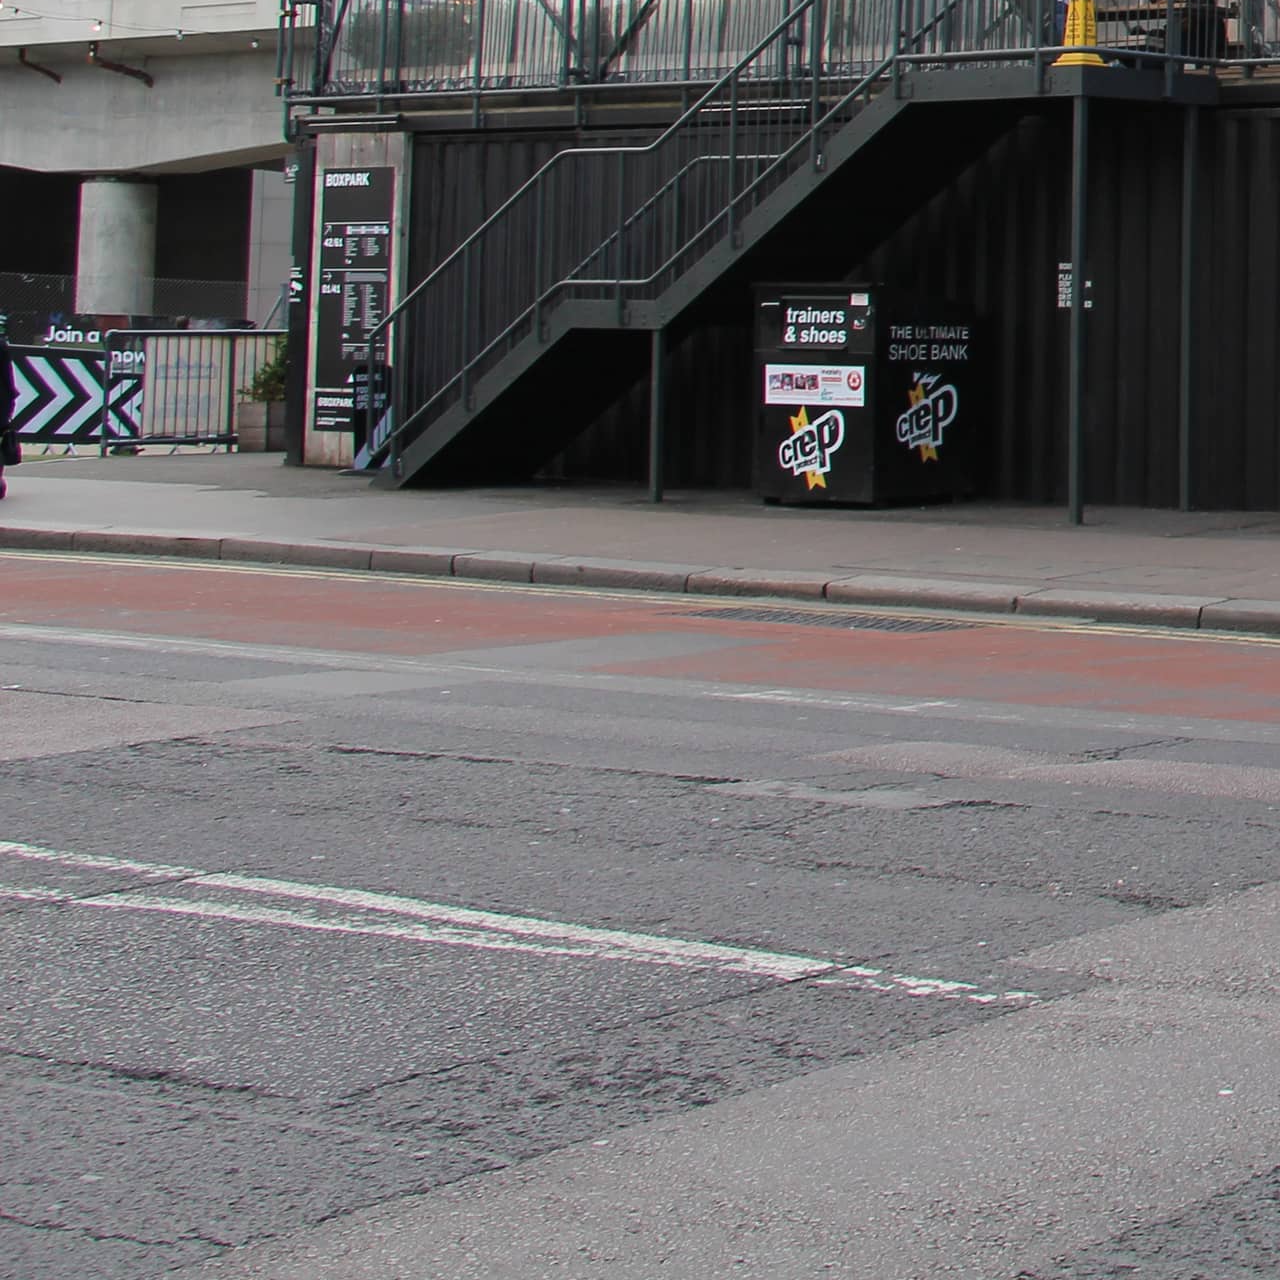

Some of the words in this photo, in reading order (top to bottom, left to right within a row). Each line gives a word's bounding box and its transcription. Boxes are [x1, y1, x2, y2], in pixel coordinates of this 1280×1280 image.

[325, 172, 370, 187] BOXPARK
[786, 307, 844, 324] trainers
[44, 325, 83, 343] Join
[785, 326, 796, 343] &
[801, 326, 847, 343] shoes
[890, 326, 912, 339] THE
[915, 326, 969, 339] ULTIMATE
[889, 344, 926, 360] SHOE
[931, 344, 968, 360] BANK
[780, 412, 842, 473] crep
